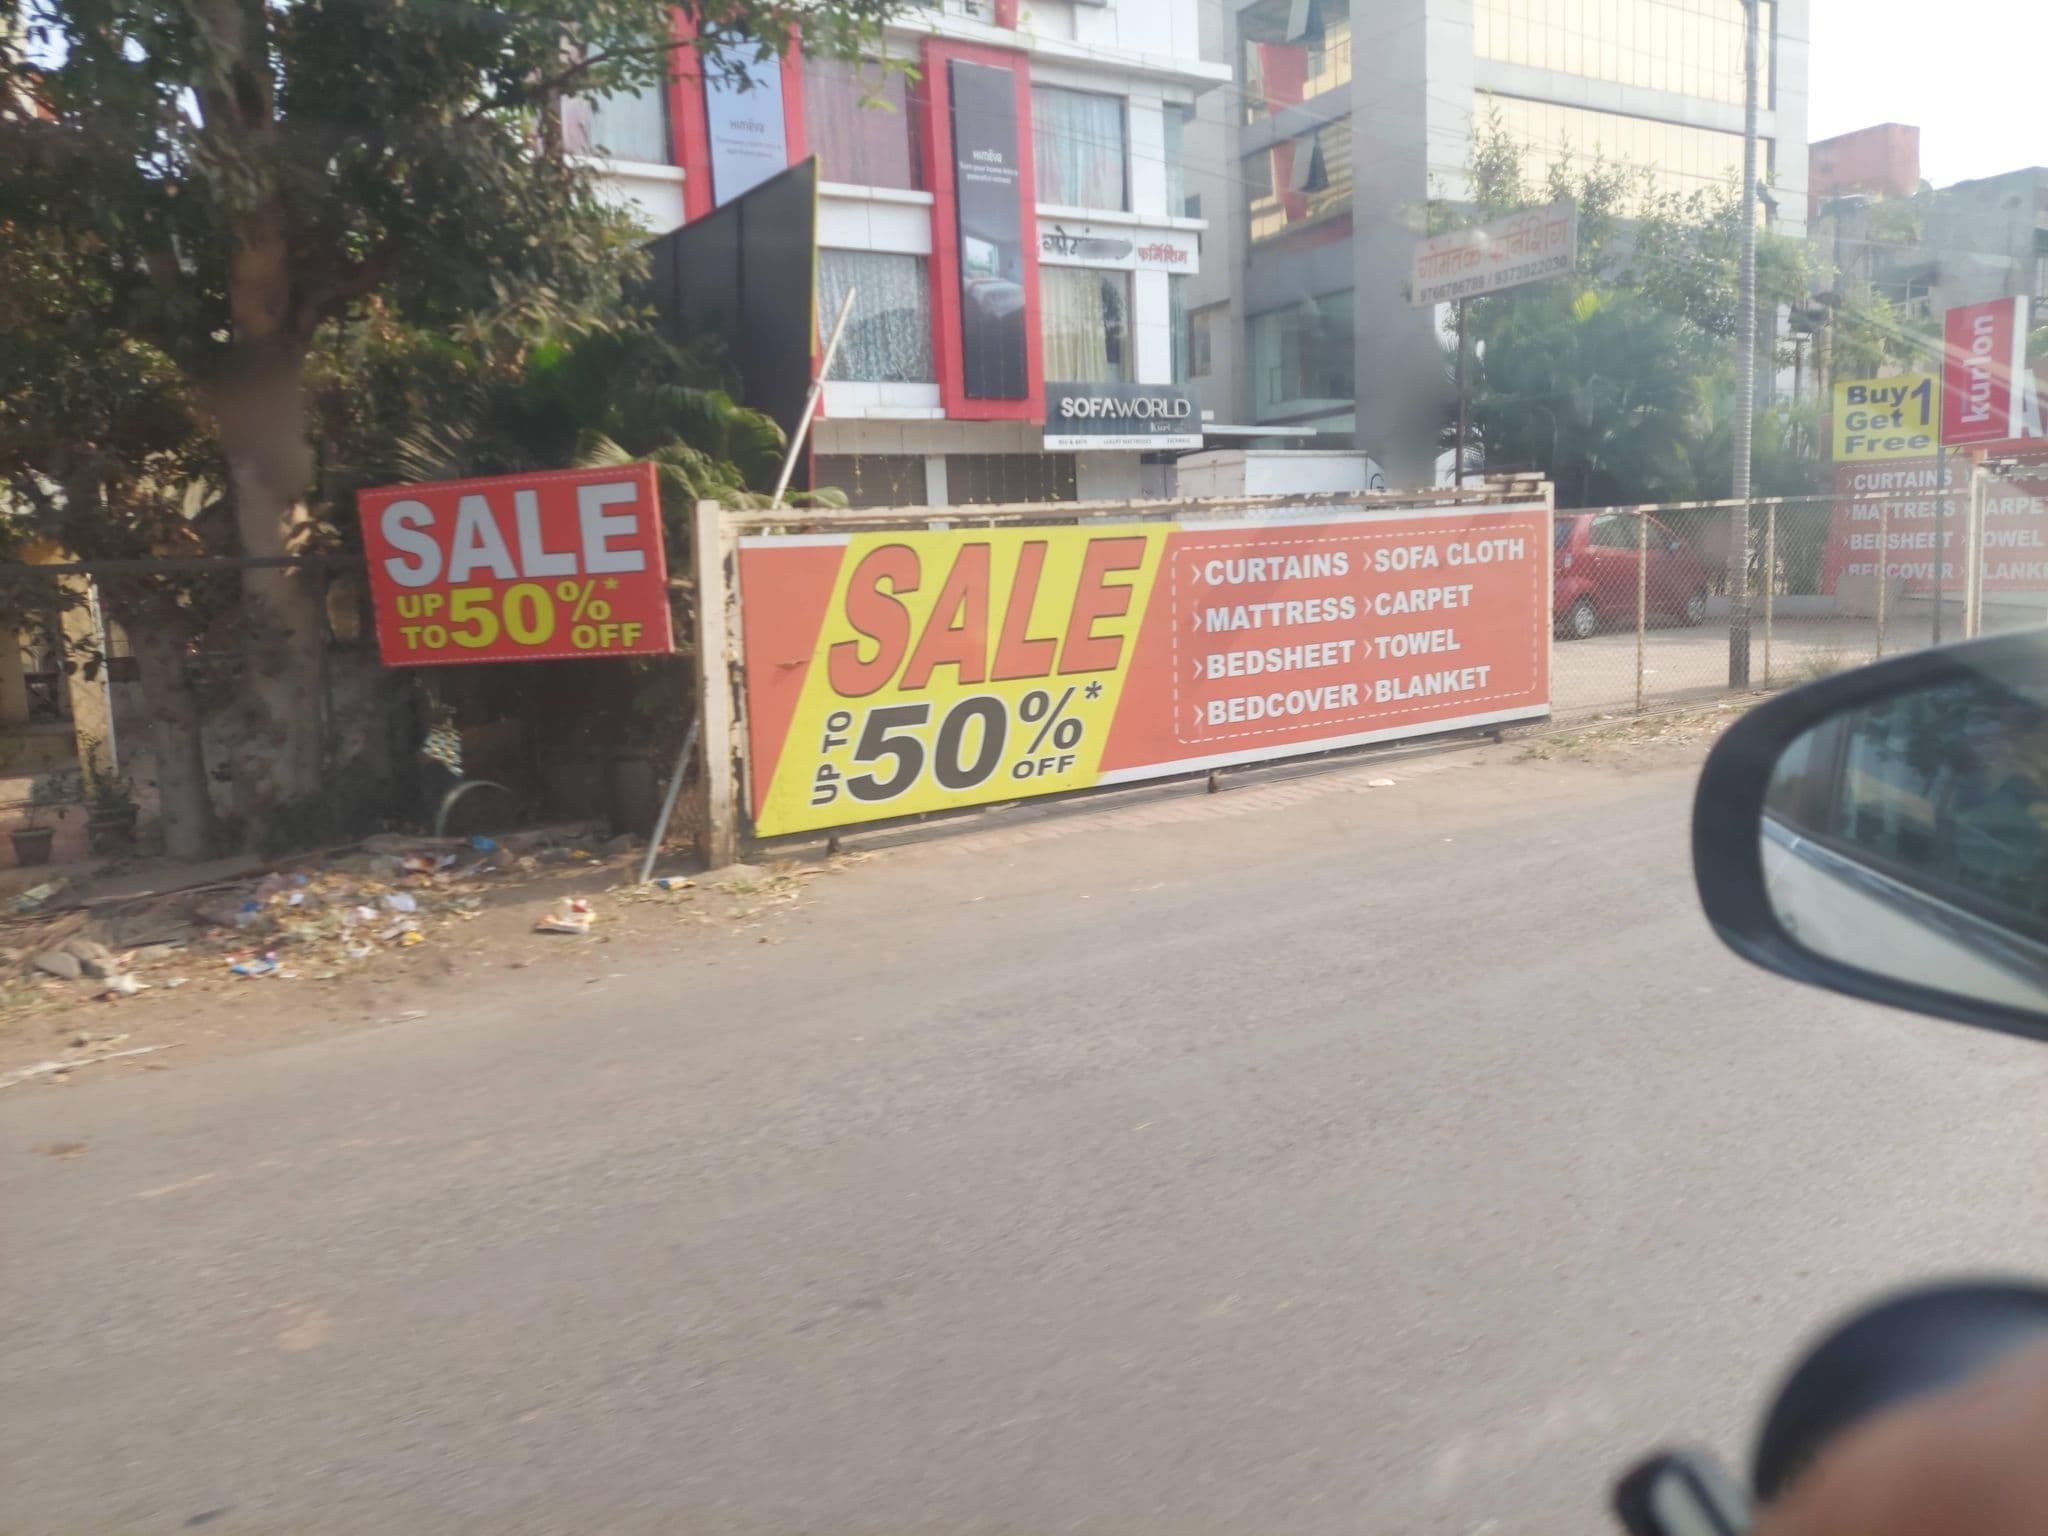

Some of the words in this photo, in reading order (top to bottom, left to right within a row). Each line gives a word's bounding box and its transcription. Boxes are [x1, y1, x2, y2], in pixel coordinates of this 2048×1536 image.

[1961, 314, 1994, 424] kurlon
[1847, 385, 1909, 408] Buy
[1911, 378, 1931, 426] 1
[1846, 408, 1903, 431] Get
[1845, 434, 1930, 454] Free
[1852, 500, 1955, 520] MATRESS
[381, 481, 646, 587] SALE
[1984, 529, 2042, 546] OWEL
[1204, 552, 1349, 586] CURTAINS
[1375, 545, 1439, 573] SOFA
[1447, 538, 1525, 567] CLOTH
[397, 593, 444, 619] UP
[828, 535, 1147, 698] SALE
[1206, 596, 1356, 633] MATTRESS
[1375, 584, 1473, 617] CARPET
[400, 625, 448, 649] TO
[571, 623, 642, 649] OFF
[1375, 629, 1461, 660] TOWEL
[1207, 640, 1355, 679] BEDSHEET
[1375, 665, 1491, 704] BLANKET
[1207, 683, 1359, 726] BEDCOVER
[823, 711, 851, 753] TO
[1012, 754, 1076, 780] OFF
[812, 764, 840, 806] UP
